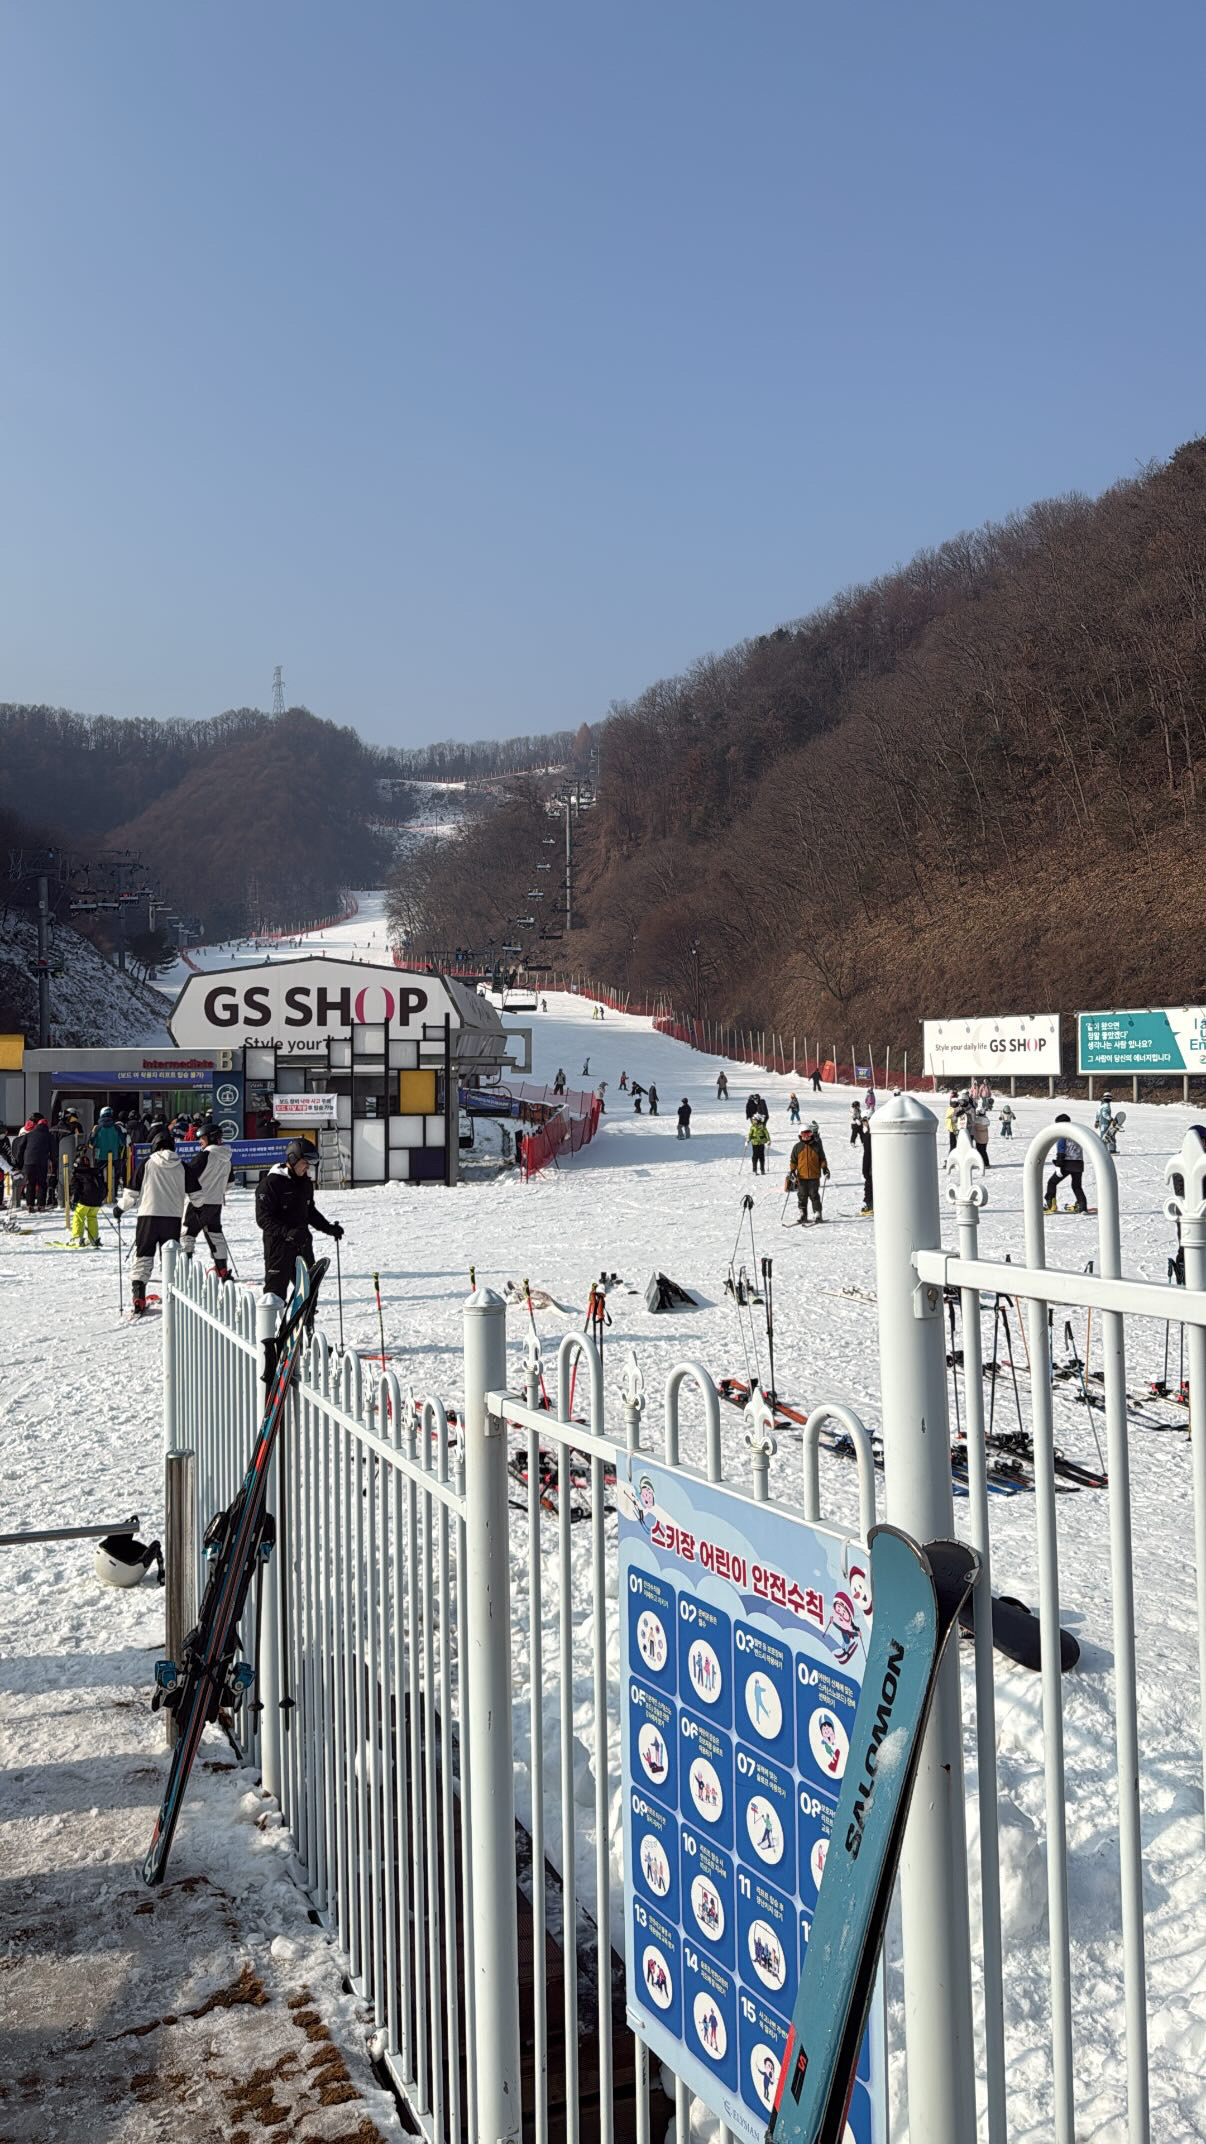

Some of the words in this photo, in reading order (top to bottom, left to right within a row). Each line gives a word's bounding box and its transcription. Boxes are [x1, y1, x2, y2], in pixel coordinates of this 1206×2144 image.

[203, 986, 272, 1027] GS
[284, 986, 428, 1027] SHOP
[1101, 1021, 1120, 1031] 왔으면
[1200, 1019, 1206, 1029] a
[287, 1040, 322, 1054] your
[935, 1043, 950, 1052] Style
[950, 1044, 963, 1052] your
[963, 1042, 977, 1052] daily
[978, 1042, 988, 1051] life
[990, 1039, 1006, 1052] GS
[1009, 1038, 1046, 1052] SHOP
[1087, 1040, 1112, 1050] 생각나는
[1114, 1040, 1127, 1049] 사람
[1128, 1039, 1152, 1048] 있나요?
[1189, 1039, 1206, 1050] En
[218, 1051, 233, 1071] B
[1087, 1055, 1094, 1063] 그
[1095, 1054, 1112, 1063] 사람이
[1114, 1054, 1133, 1063] 당신의
[1133, 1053, 1171, 1062] 에너지입니다
[630, 1574, 642, 1593] 01
[652, 1520, 696, 1561] 스키장
[700, 1541, 748, 1587] 어린이
[752, 1564, 824, 1626] 안전수칙
[680, 1601, 696, 1622] 02
[736, 1630, 755, 1652] 03
[798, 1663, 819, 1685] 04
[631, 1685, 646, 1706] 05
[682, 1717, 698, 1739] 06
[845, 1638, 905, 1861] SALOMON
[737, 1753, 755, 1776] 07
[632, 1795, 648, 1820] 09
[800, 1792, 822, 1817] 08
[683, 1833, 696, 1856] 10
[739, 1874, 750, 1899] 11
[635, 1904, 647, 1927] 13
[802, 1921, 811, 1942] 1
[685, 1948, 698, 1972] 14
[741, 1997, 756, 2023] 15
[730, 2109, 760, 2143] ELYSIAN
